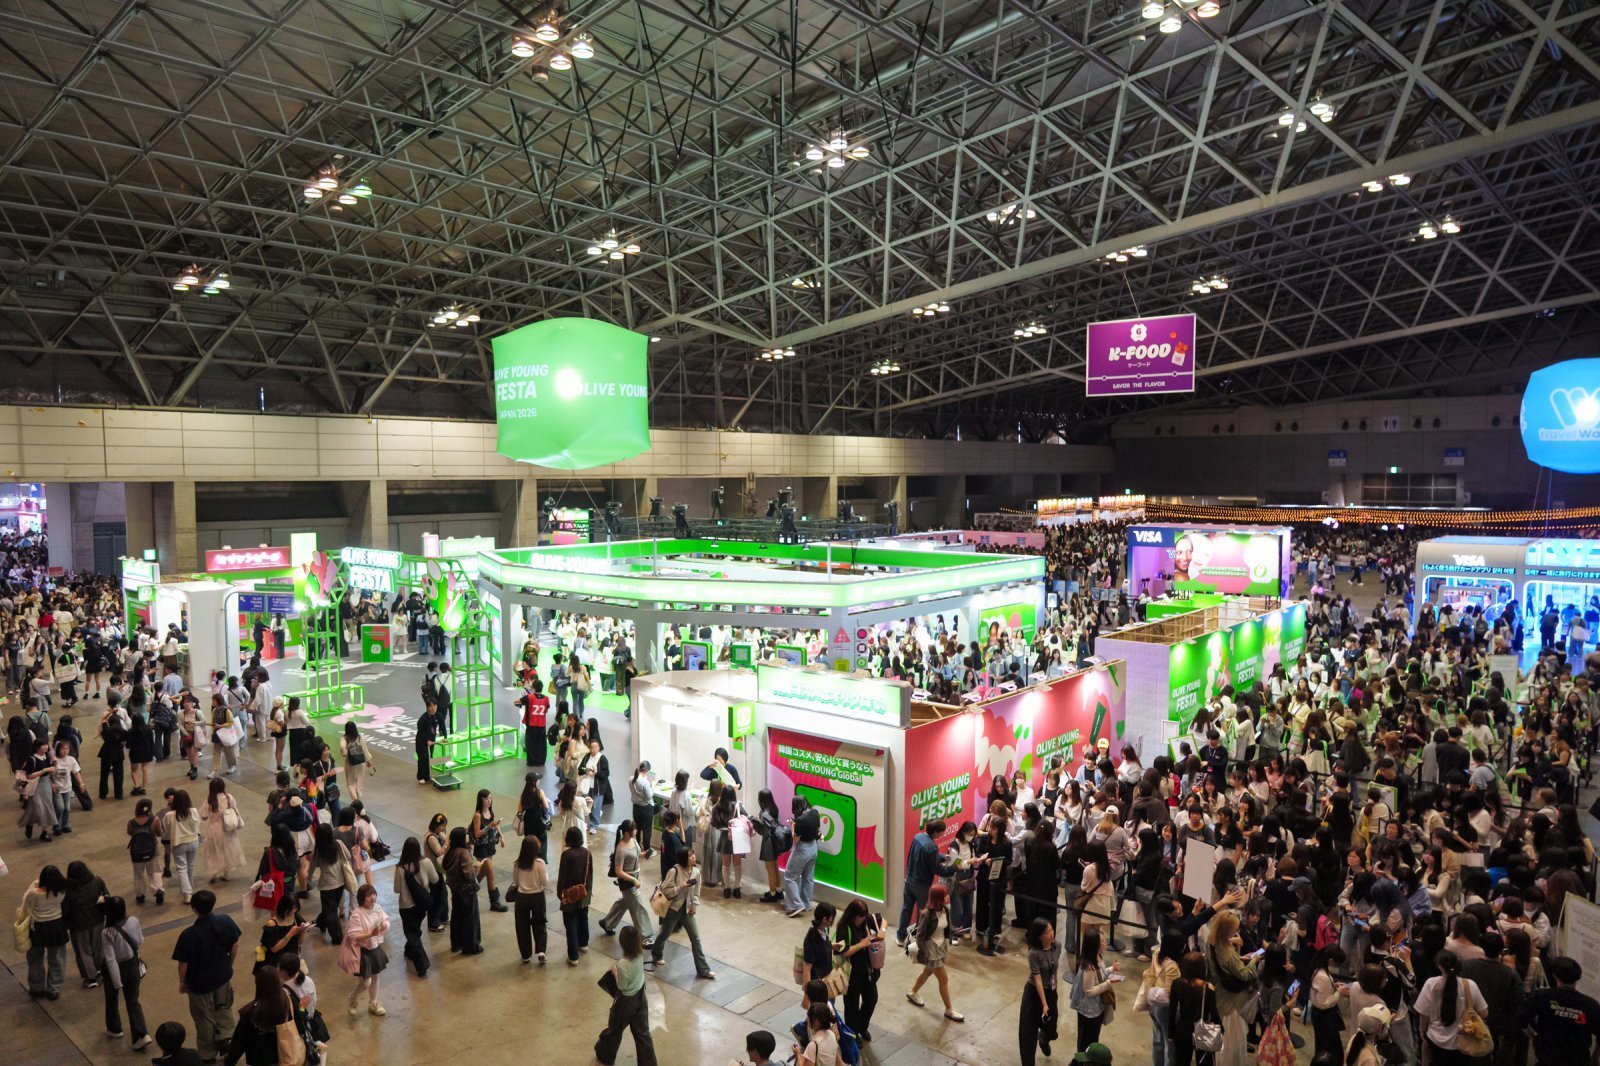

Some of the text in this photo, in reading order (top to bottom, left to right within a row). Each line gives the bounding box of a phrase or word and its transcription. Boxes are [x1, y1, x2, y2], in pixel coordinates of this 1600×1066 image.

[1108, 343, 1171, 361] K-FOOD
[511, 364, 549, 378] YOUNG
[497, 381, 537, 401] FESTA
[517, 408, 537, 418] 2026
[1133, 531, 1162, 543] VISA
[342, 547, 366, 564] OLIVE
[1452, 555, 1485, 567] VISA
[350, 566, 392, 592] FESTA
[1237, 666, 1254, 685] FESTA
[1172, 678, 1200, 698] OLIVE YOUNG
[532, 704, 546, 715] 22
[1175, 691, 1197, 712] FESTA
[1036, 728, 1079, 756] OLIVE YOUNG
[789, 759, 862, 784] OLIVE YOUNG Global
[911, 773, 970, 807] OLIVE YOUNG
[919, 792, 962, 827] FESTA
